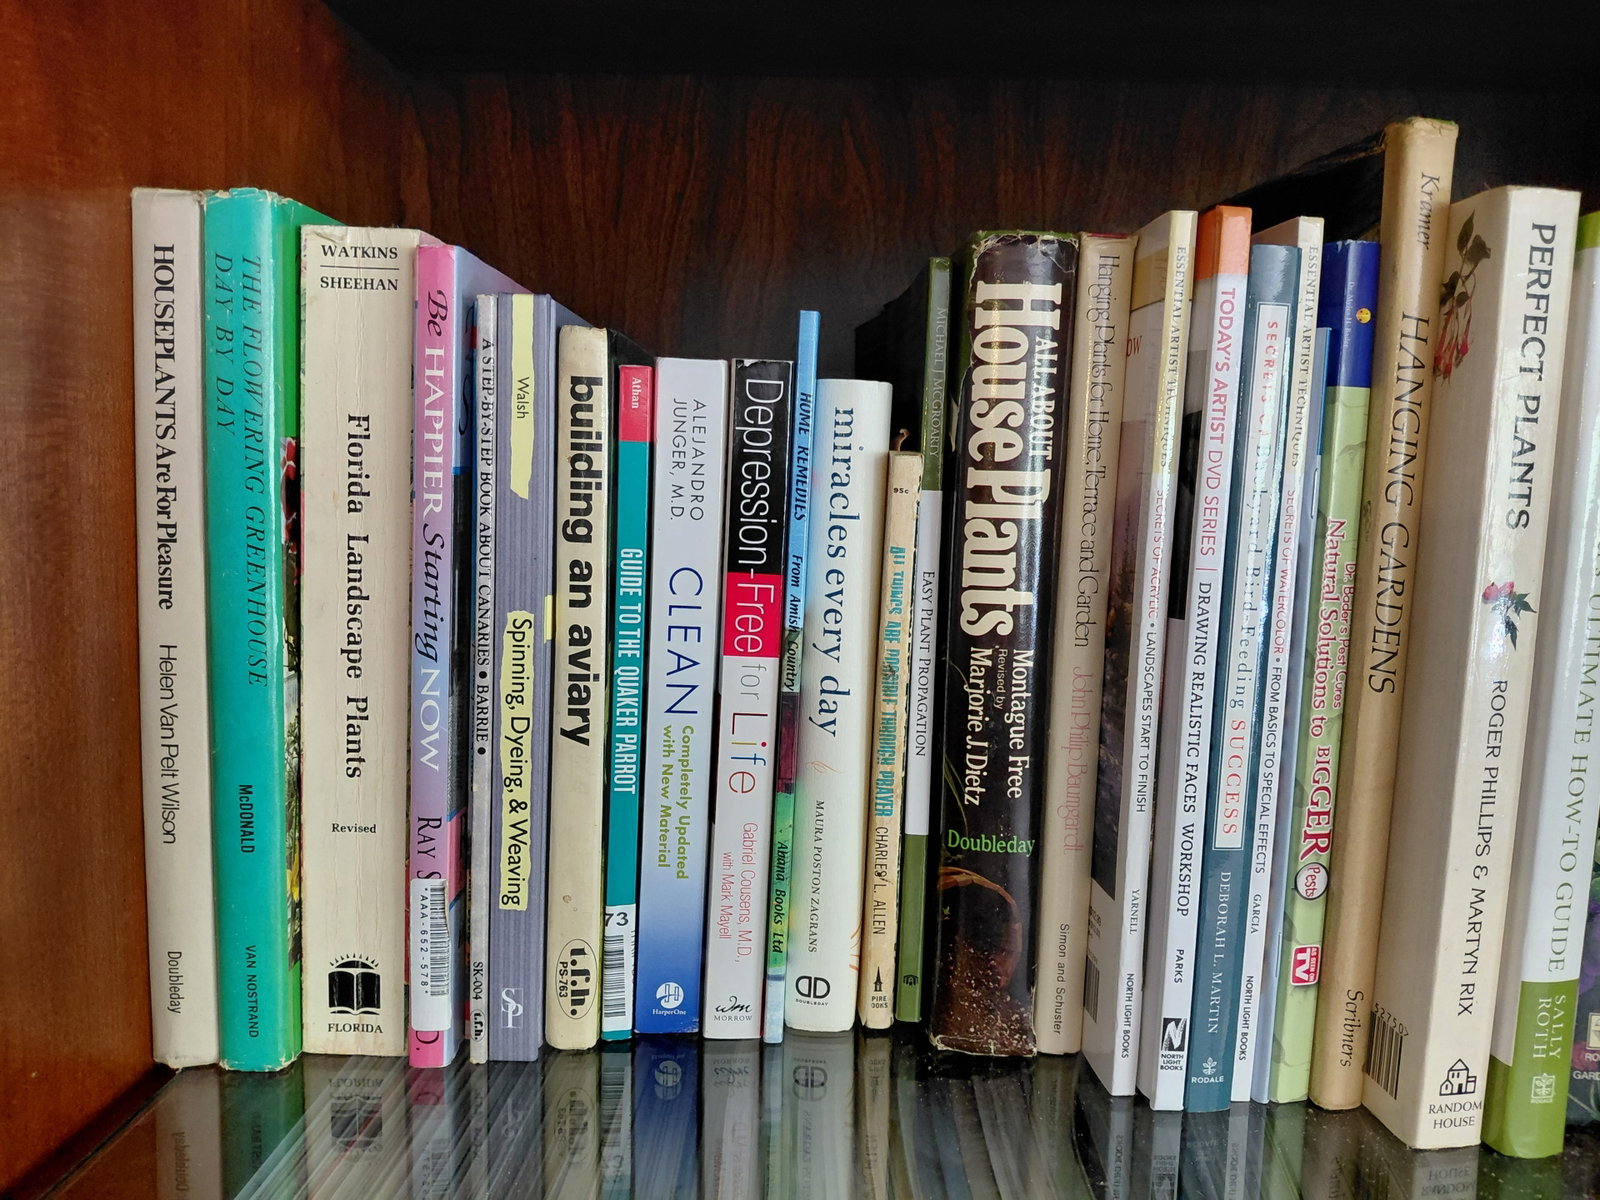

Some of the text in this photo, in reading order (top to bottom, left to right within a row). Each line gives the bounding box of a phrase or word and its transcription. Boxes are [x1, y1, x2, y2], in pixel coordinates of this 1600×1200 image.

[321, 245, 398, 259] WATKINS
[1417, 172, 1440, 250] Kramer
[214, 252, 236, 436] DAY BY DAY
[320, 276, 398, 290] SHEEHAN
[153, 244, 178, 609] HOUSEPLANTS Are For Pleasure
[516, 377, 531, 419] Walsh
[631, 377, 642, 409] Athan
[1029, 385, 1056, 460] ABOUT
[1506, 222, 1556, 530] PERFECT PLANTS
[241, 255, 268, 687] THE FLOWERING GREENHOUSE
[690, 399, 706, 521] ALEJANDRO
[960, 280, 1062, 636] House Plants
[1074, 255, 1120, 647] Hanging Plants Home, Terrace and Garden
[1368, 312, 1430, 694] HANGING GARDENS
[341, 414, 370, 779] Florida Landscape Plants
[417, 290, 448, 772] Be HAPPIER Starting NOW
[475, 357, 495, 742] STEP-BY-STEP BOOK ABOUT CANARIES BARRIE
[560, 376, 603, 746] building an aviary
[729, 379, 784, 794] Depression-Free Life
[784, 391, 812, 692] HOME REMEDIES From Amish Country
[808, 406, 863, 737] miracles every day
[613, 548, 643, 794] GUIDE THE QUAKER PARROT
[664, 567, 703, 714] CLEAN
[915, 570, 935, 757] EASY PLANT PROPAGATION
[1142, 632, 1157, 711] LANDSCAPES
[1174, 288, 1236, 983] TODAY'S ARTIST DVD SERIES DRAWING REALISTIC FACES WORKSHOP PARKS
[1232, 567, 1261, 708] Bird-Feeding
[1333, 670, 1347, 708] Cures
[160, 644, 180, 844] Helen Van Pelt Wilson
[501, 618, 532, 905] Spinning, Dyeing, & Weaving
[964, 646, 994, 805] Marjorie Dietz
[1004, 648, 1034, 798] Montague Free
[1299, 519, 1347, 898] Natural Solutions to BIGGER Pests
[238, 784, 254, 853] McDONALD
[332, 823, 377, 833] Revised
[417, 816, 443, 858] RAY
[658, 725, 676, 867] with New Material
[672, 726, 694, 879] Completely Updated
[947, 829, 1035, 857] Doubleday
[1057, 711, 1092, 855] Philip Baumgardt
[1222, 720, 1247, 835] SUCCESS
[1239, 569, 1291, 1061] WATERCOLOR FROM NORTH BOOKS
[1548, 594, 1600, 973] ULTIMATE HOW-TO GUIDE
[741, 823, 759, 865] Gabriel
[772, 841, 789, 953] Abana Ltd
[808, 801, 825, 953] MAURA POSTON ZAGRANS
[1457, 680, 1508, 1017] ROGER PHILLIPS & MARTYN RIX
[166, 951, 183, 1014] Doubleday
[473, 961, 483, 1000] SK-004
[559, 961, 568, 998] PS-763
[570, 948, 590, 1016] t.f.h.
[717, 905, 733, 939] Mayell
[873, 900, 887, 935] ALLEN
[1053, 923, 1070, 1035] Simon Schuster
[1208, 871, 1232, 1034] DEBORAH MARTIN
[1296, 947, 1311, 981] TV
[246, 945, 259, 1038] VAN NOSTRAND
[328, 1023, 383, 1033] FLORIDA
[474, 1012, 483, 1040] t.f.h.
[1340, 989, 1364, 1067] Scribners
[1532, 998, 1552, 1059] ROTH
[1549, 995, 1566, 1059] SALLY
[1428, 1100, 1482, 1114] RANDOM
[1433, 1116, 1475, 1129] HOUSE
